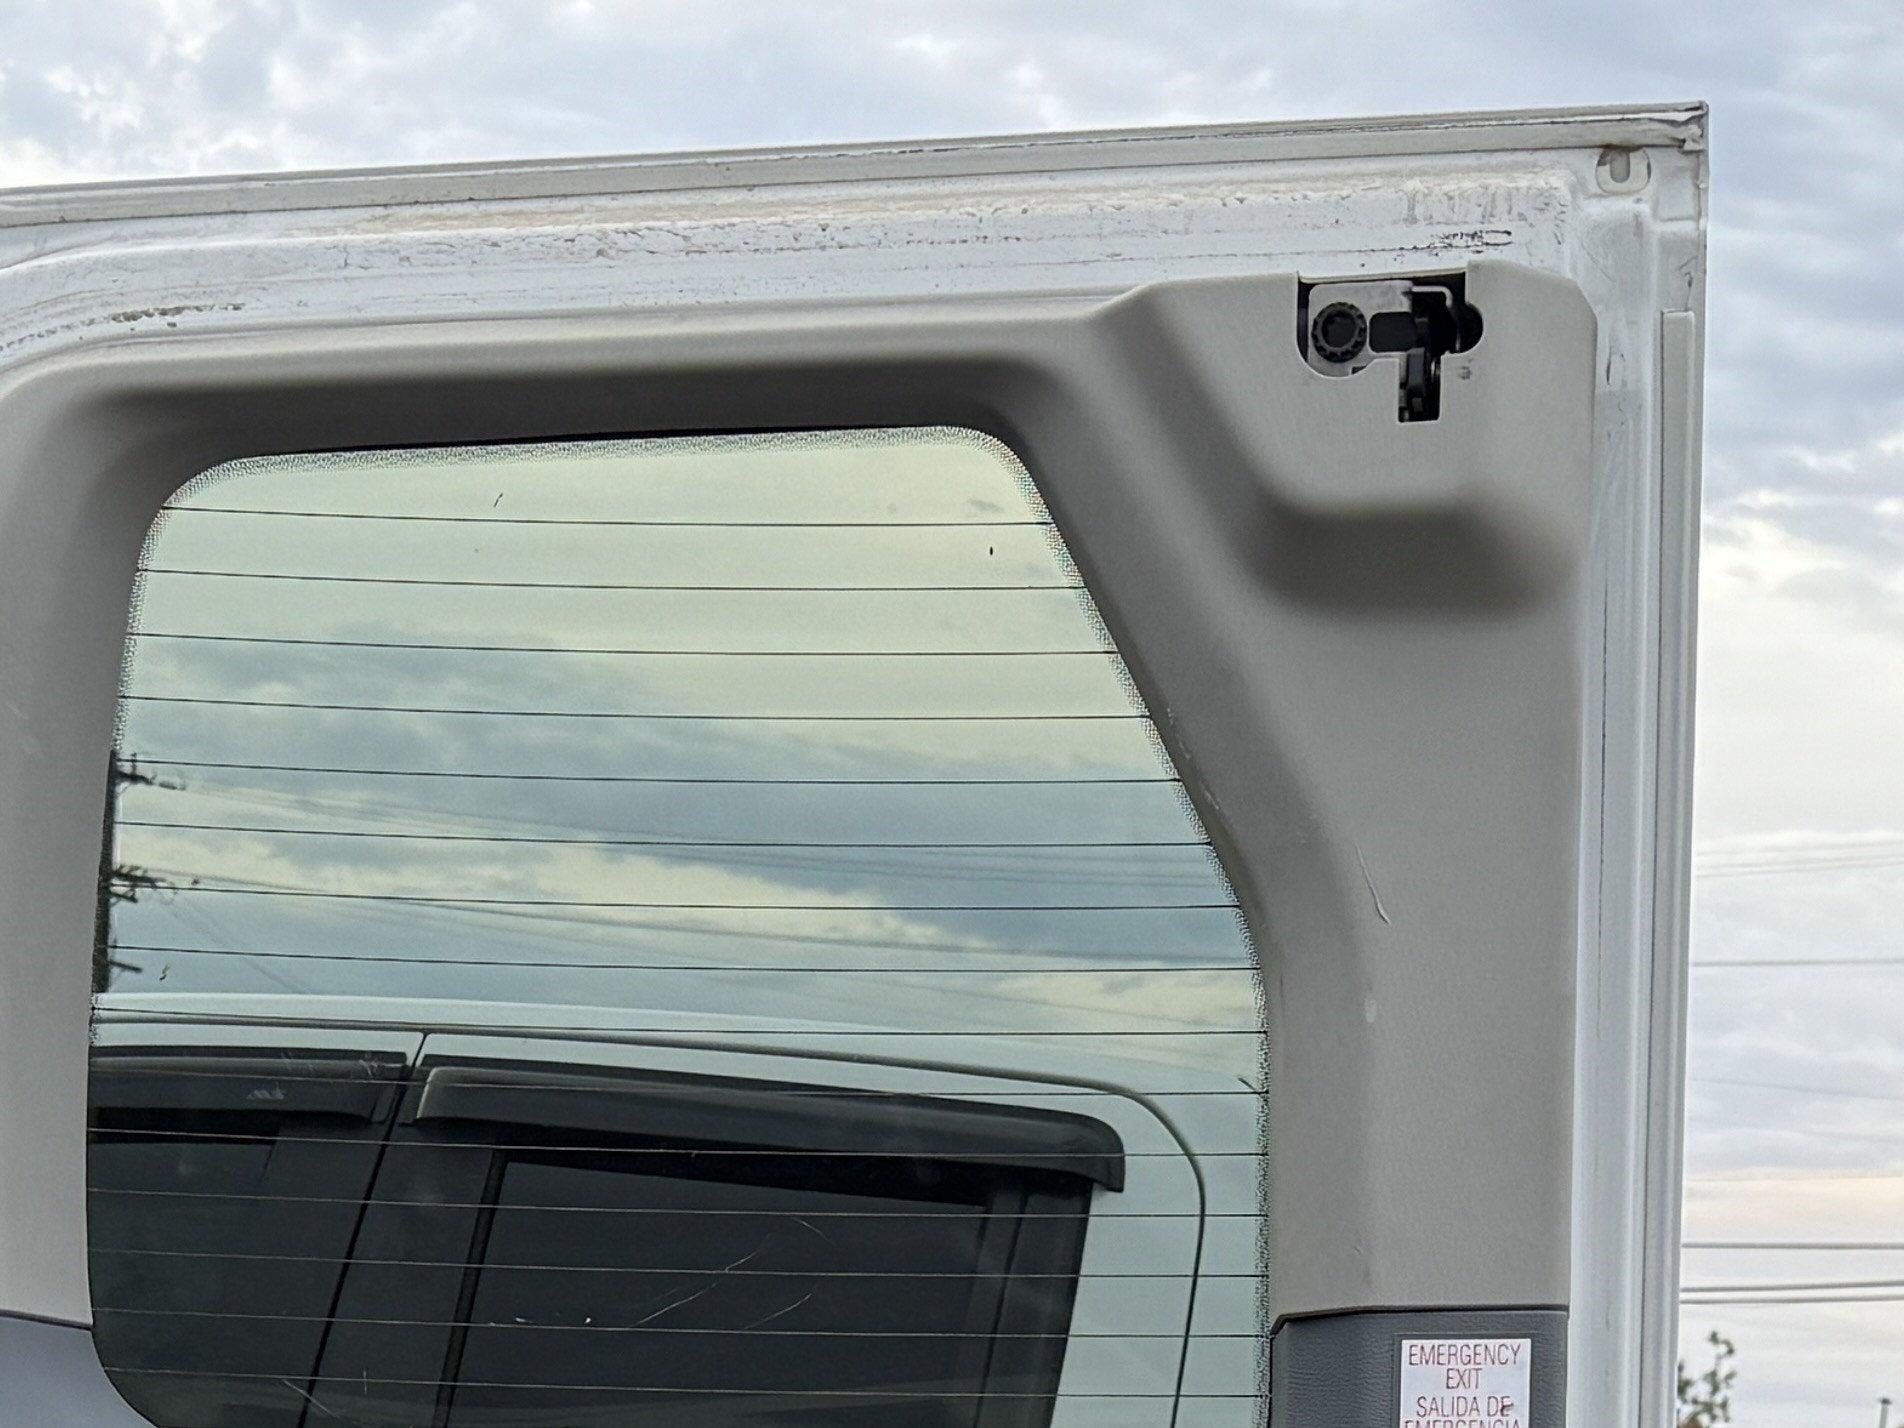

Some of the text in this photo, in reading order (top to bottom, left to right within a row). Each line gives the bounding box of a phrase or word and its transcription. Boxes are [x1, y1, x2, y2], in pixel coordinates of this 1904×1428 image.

[1408, 1343, 1521, 1366] EMERGENCY
[1446, 1367, 1483, 1390] EXIT
[1416, 1395, 1512, 1418] SALIDA DE
